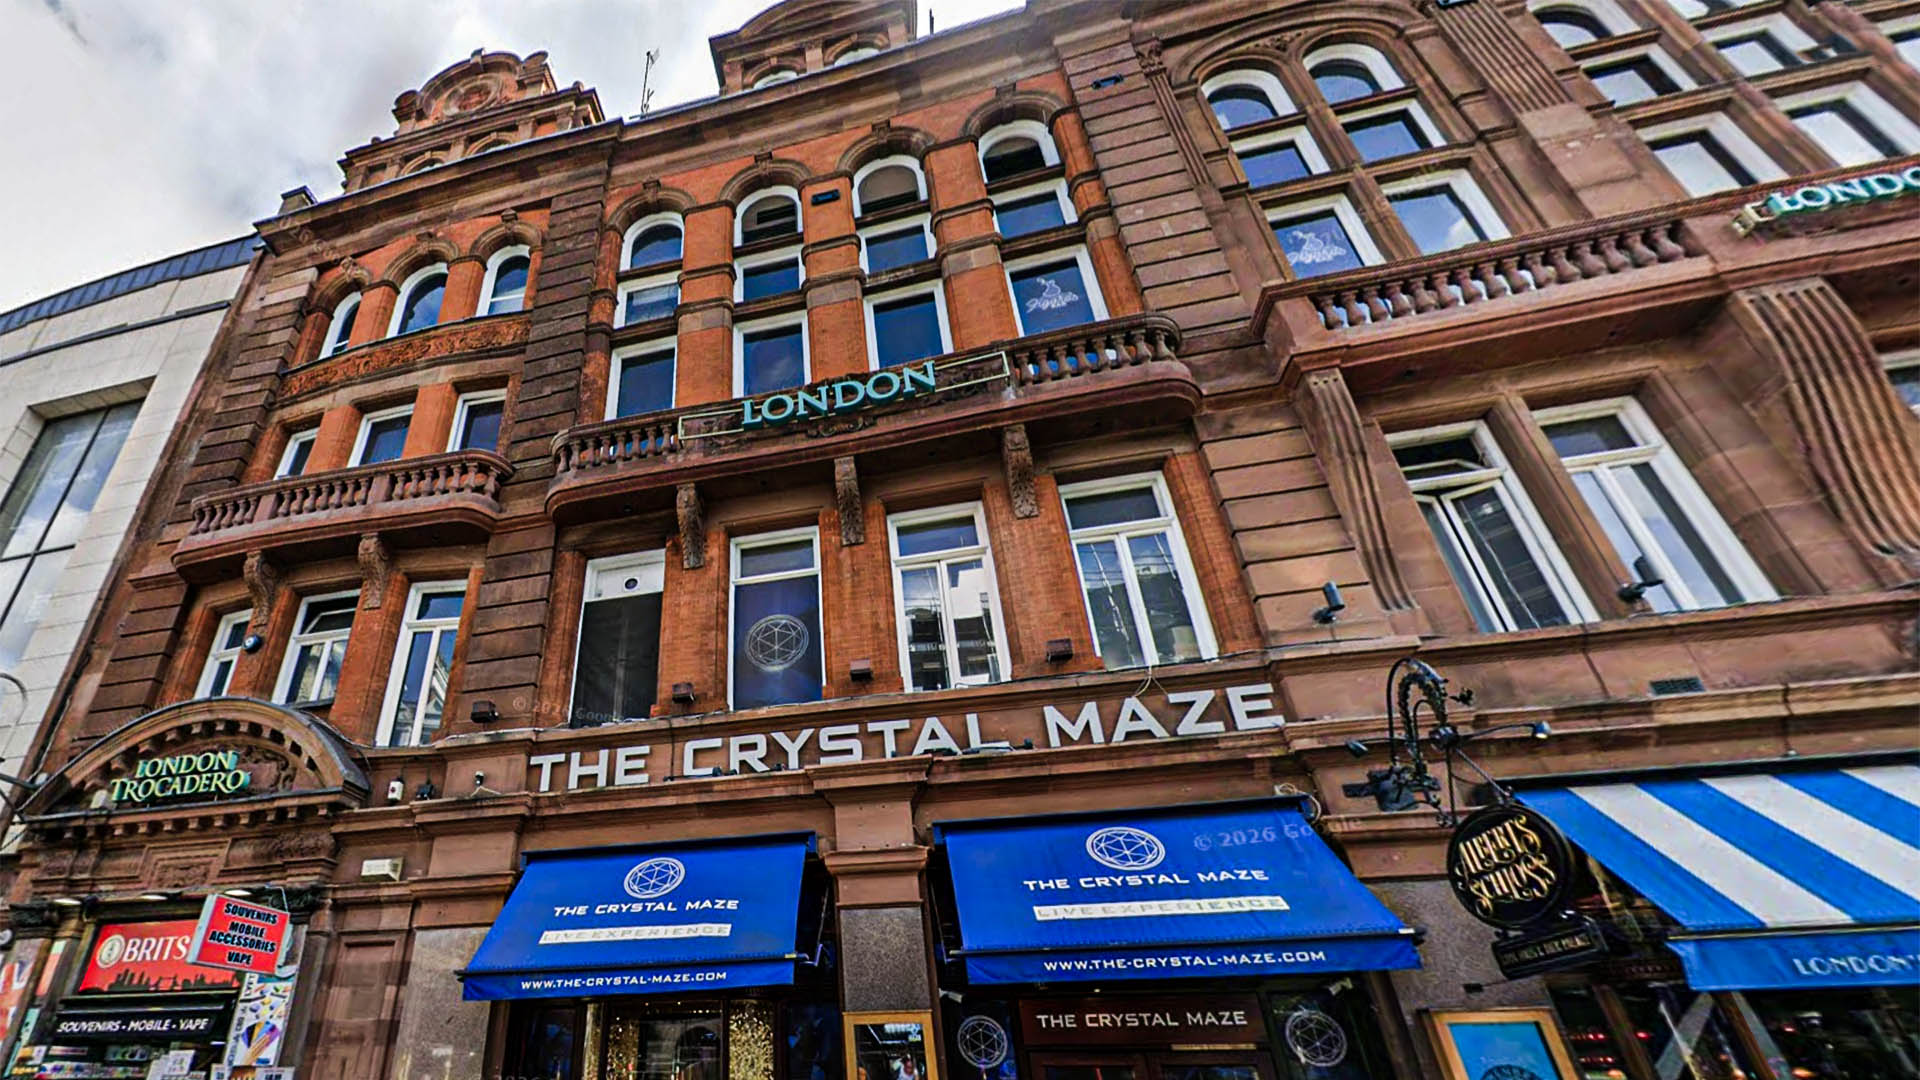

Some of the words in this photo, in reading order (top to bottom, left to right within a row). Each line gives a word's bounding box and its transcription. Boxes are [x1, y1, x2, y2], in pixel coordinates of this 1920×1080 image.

[742, 360, 935, 430] LONDON
[530, 745, 650, 792] THE
[683, 714, 1011, 777] CRYSTAL
[1043, 683, 1285, 748] MAZE
[135, 751, 239, 779] LONDON
[111, 769, 251, 802] TROCADERO
[1024, 878, 1070, 891] THE
[1079, 873, 1189, 889] CRYSTAL
[1199, 869, 1269, 882] MAZE
[224, 903, 278, 925] SOUVENIRS
[554, 905, 588, 917] THE
[594, 901, 677, 915] CRYSTAL
[685, 899, 739, 911] MAZE
[1037, 905, 1093, 918] LIVE
[1099, 897, 1288, 916] EXPERIENCE
[228, 921, 265, 938] MOBILE
[591, 925, 730, 940] EXPERIENCE
[122, 934, 190, 963] BRITS
[208, 930, 276, 953] ACCESSORIES
[226, 950, 253, 965] VAPE
[1044, 951, 1326, 971] WWW.THE-CRYSTAL-MAZE.COM
[522, 971, 727, 990] WWW.THE-CRYSTAL-MAZE.COM
[56, 1019, 122, 1033] SOUVENIRS
[128, 1018, 170, 1032] MOBILE
[179, 1017, 209, 1031] VAPE
[1036, 1014, 1078, 1028] THE
[1085, 1012, 1180, 1027] CRYSTAL
[1186, 1010, 1248, 1025] MAZE
